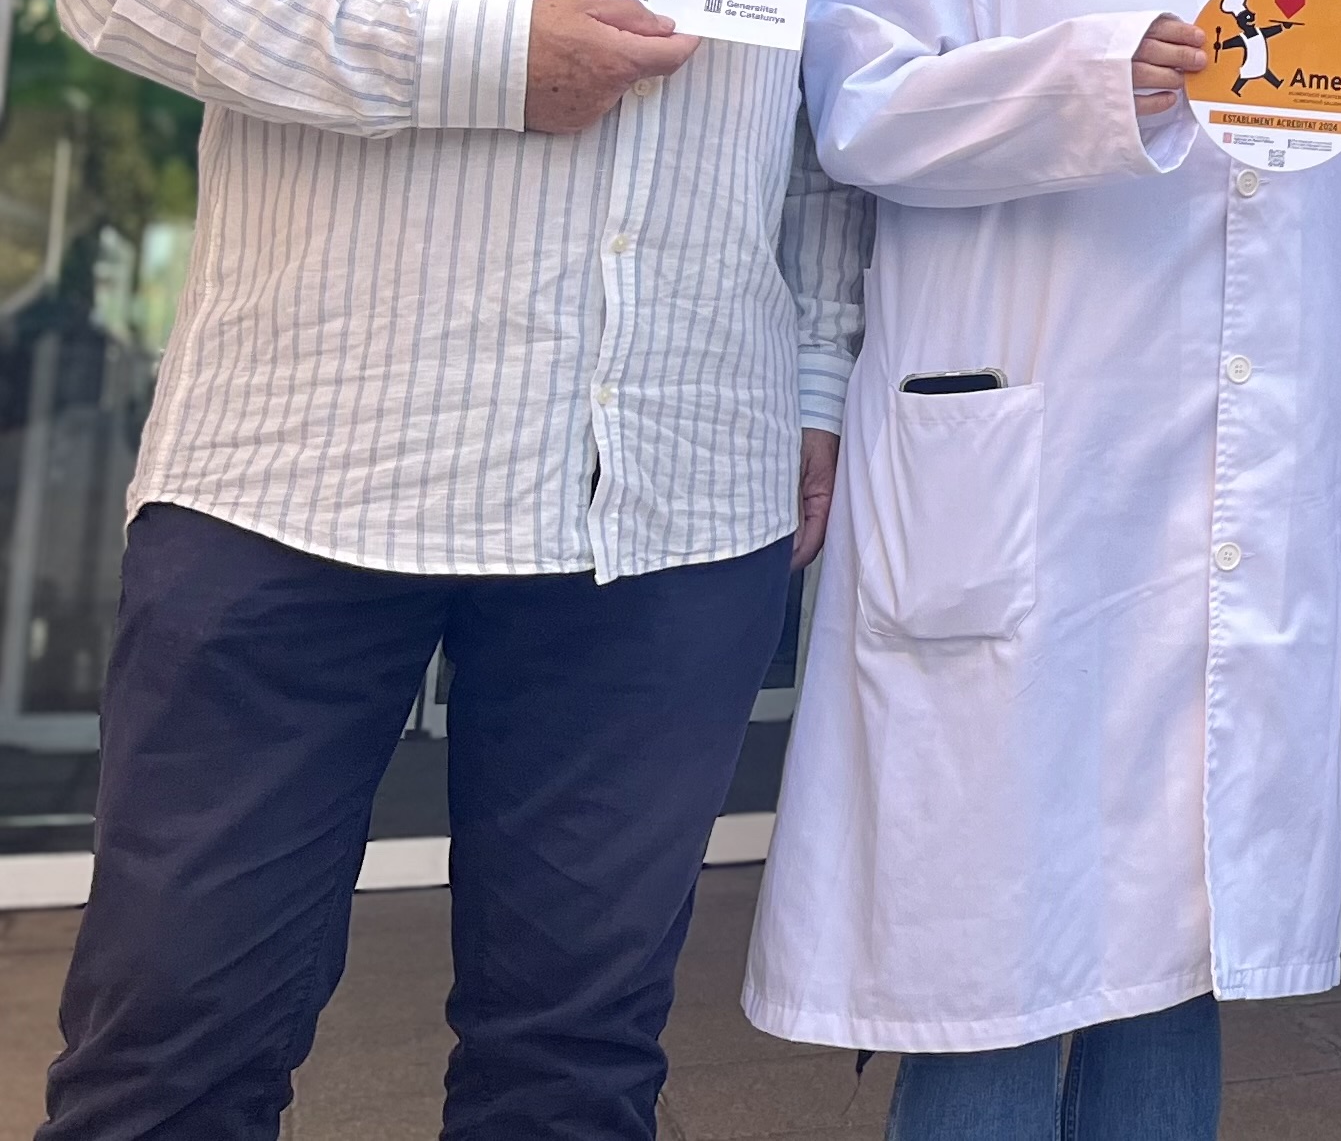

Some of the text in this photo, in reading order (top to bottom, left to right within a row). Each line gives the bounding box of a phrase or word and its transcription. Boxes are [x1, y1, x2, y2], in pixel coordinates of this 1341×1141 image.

[726, 0, 778, 14] Generalitat
[724, 8, 786, 24] de Catalunya
